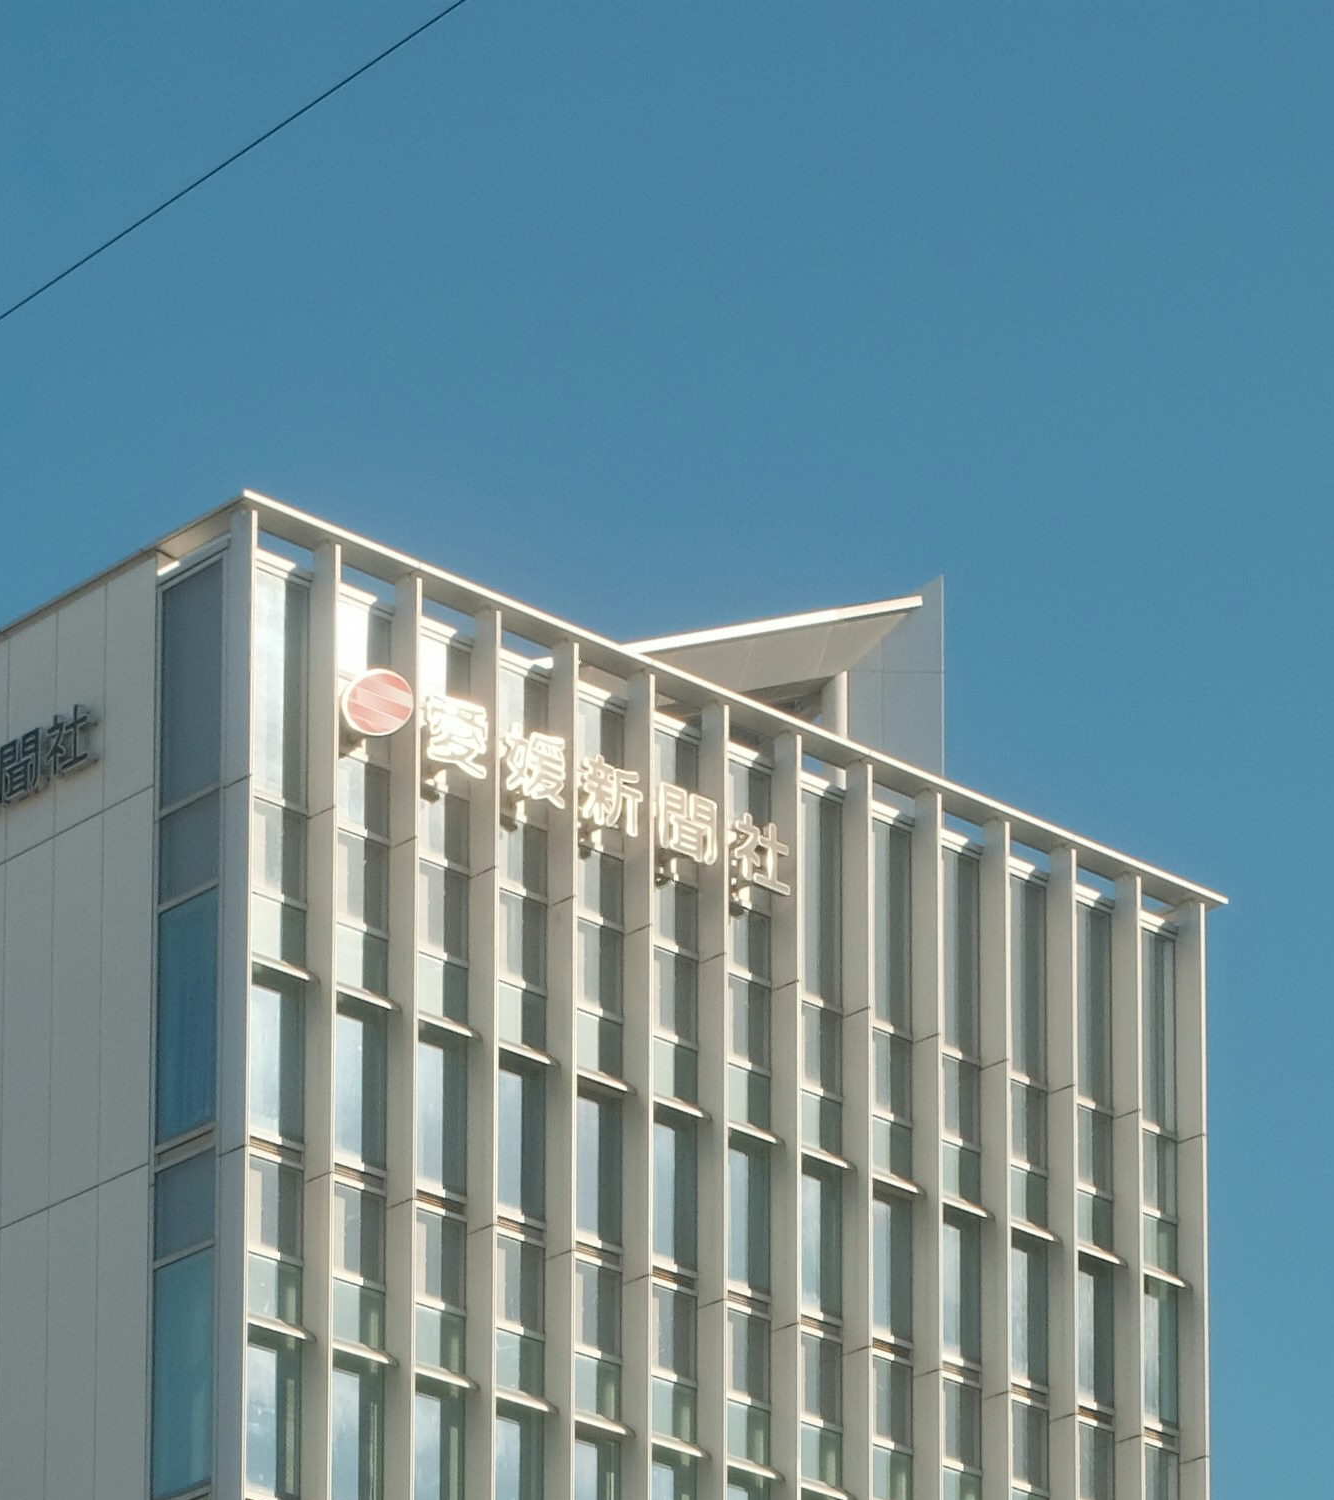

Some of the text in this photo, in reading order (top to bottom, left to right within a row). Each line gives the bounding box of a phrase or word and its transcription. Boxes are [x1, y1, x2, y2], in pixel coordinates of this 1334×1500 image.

[419, 695, 792, 897] 愛媛新聞社
